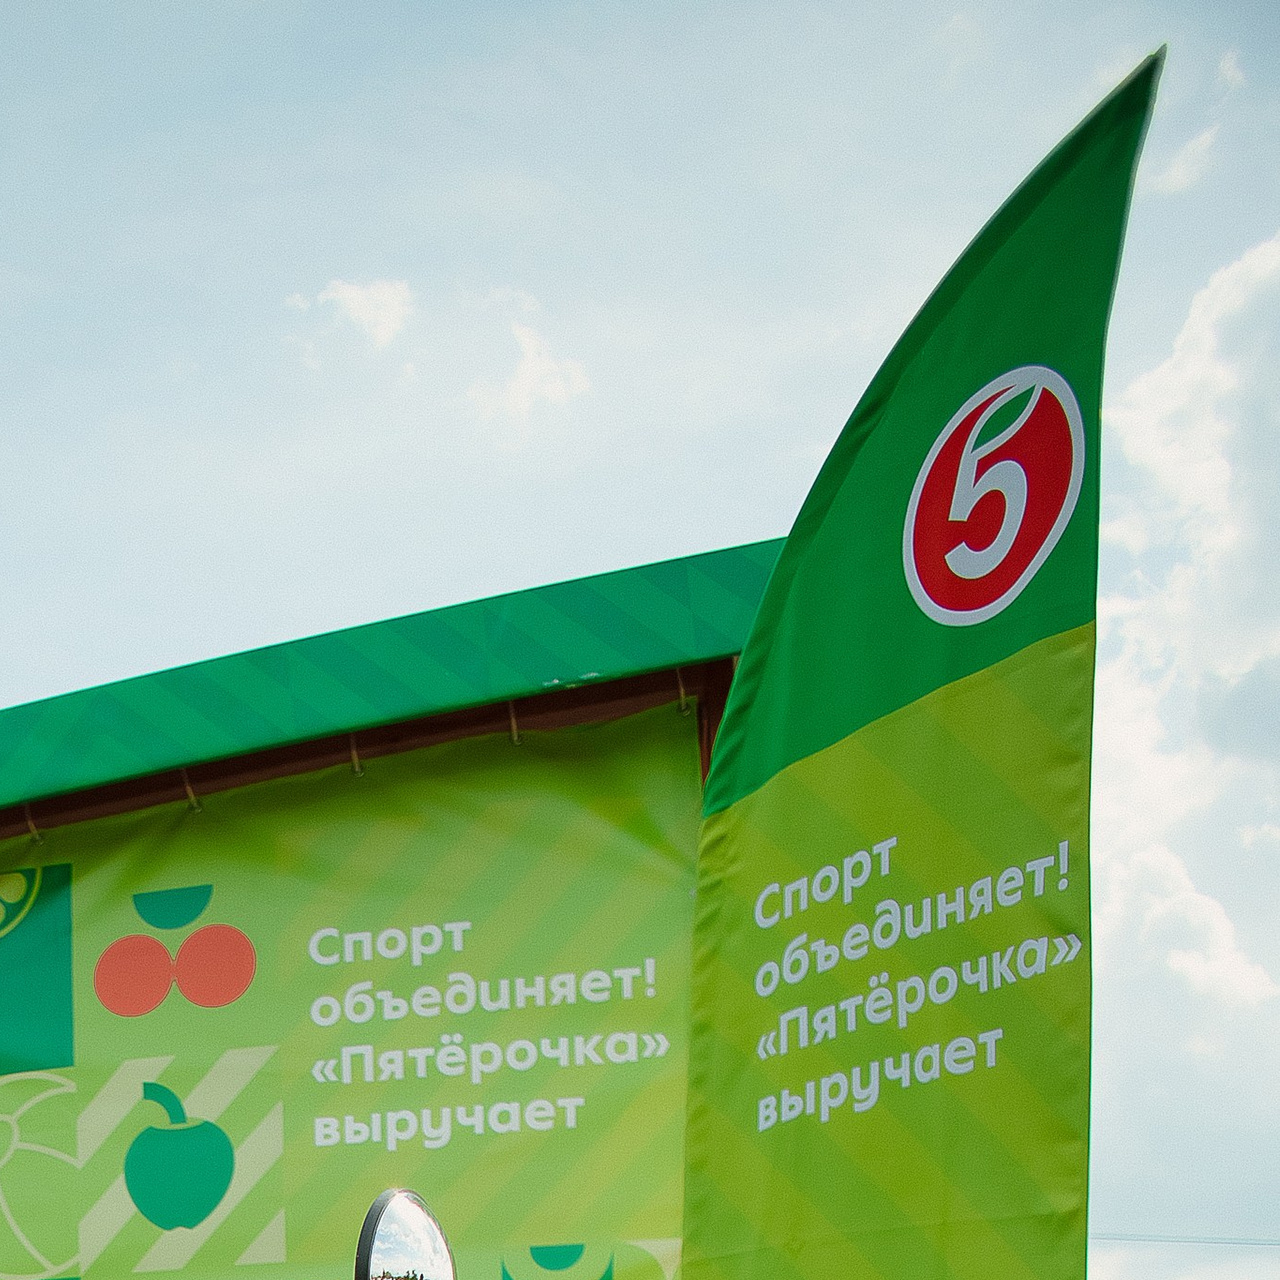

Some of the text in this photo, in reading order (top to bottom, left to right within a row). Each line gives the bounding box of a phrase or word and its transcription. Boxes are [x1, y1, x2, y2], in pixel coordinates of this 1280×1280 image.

[753, 836, 898, 929] Спорт
[754, 839, 1069, 998] объединяет!
[308, 920, 471, 966] Спорт
[310, 957, 657, 1027] объединяет!
[757, 933, 1083, 1061] «Пятёрочка»
[311, 1031, 671, 1085] «Пятёрочка»
[757, 1028, 1004, 1133] выручает
[314, 1097, 586, 1151] выручает
